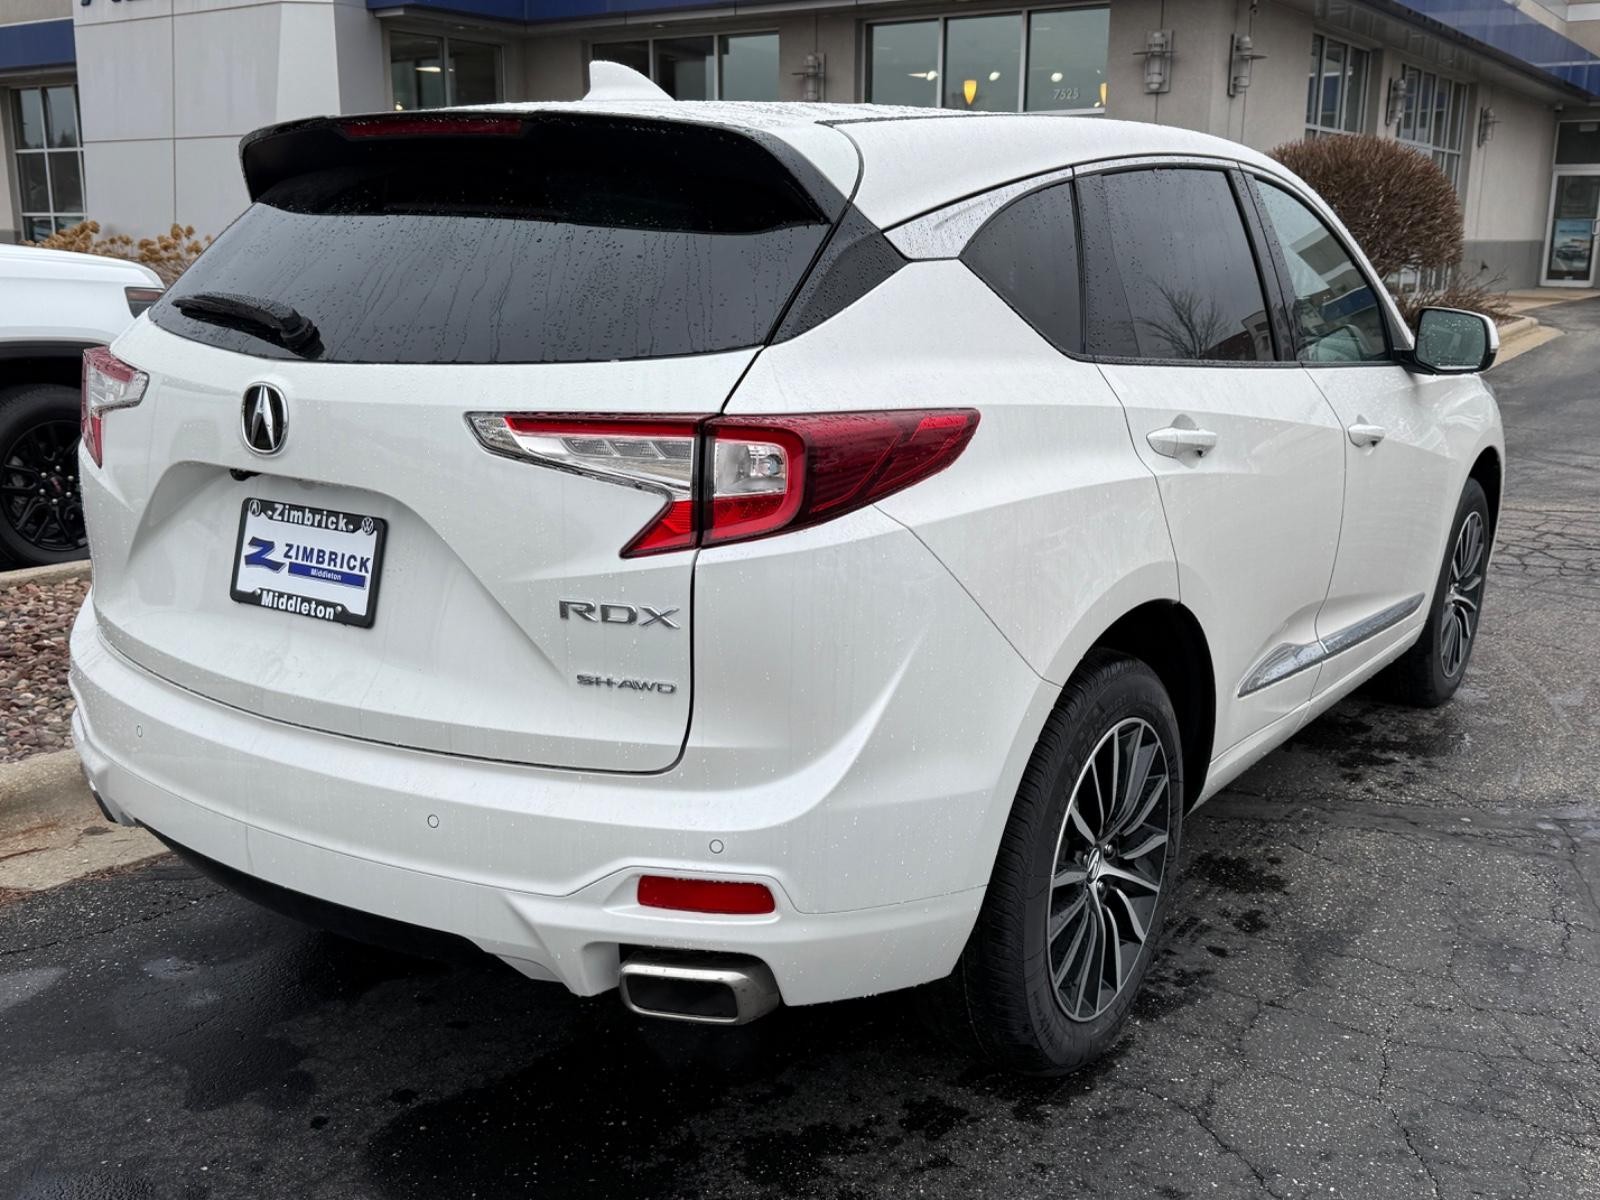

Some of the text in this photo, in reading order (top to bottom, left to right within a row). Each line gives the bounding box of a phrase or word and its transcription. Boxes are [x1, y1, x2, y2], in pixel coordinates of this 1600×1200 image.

[272, 504, 348, 531] Zimbrick
[283, 543, 371, 574] ZIMBRICK
[310, 569, 342, 580] Middleton
[260, 590, 335, 620] Middleton
[559, 599, 680, 629] RDX
